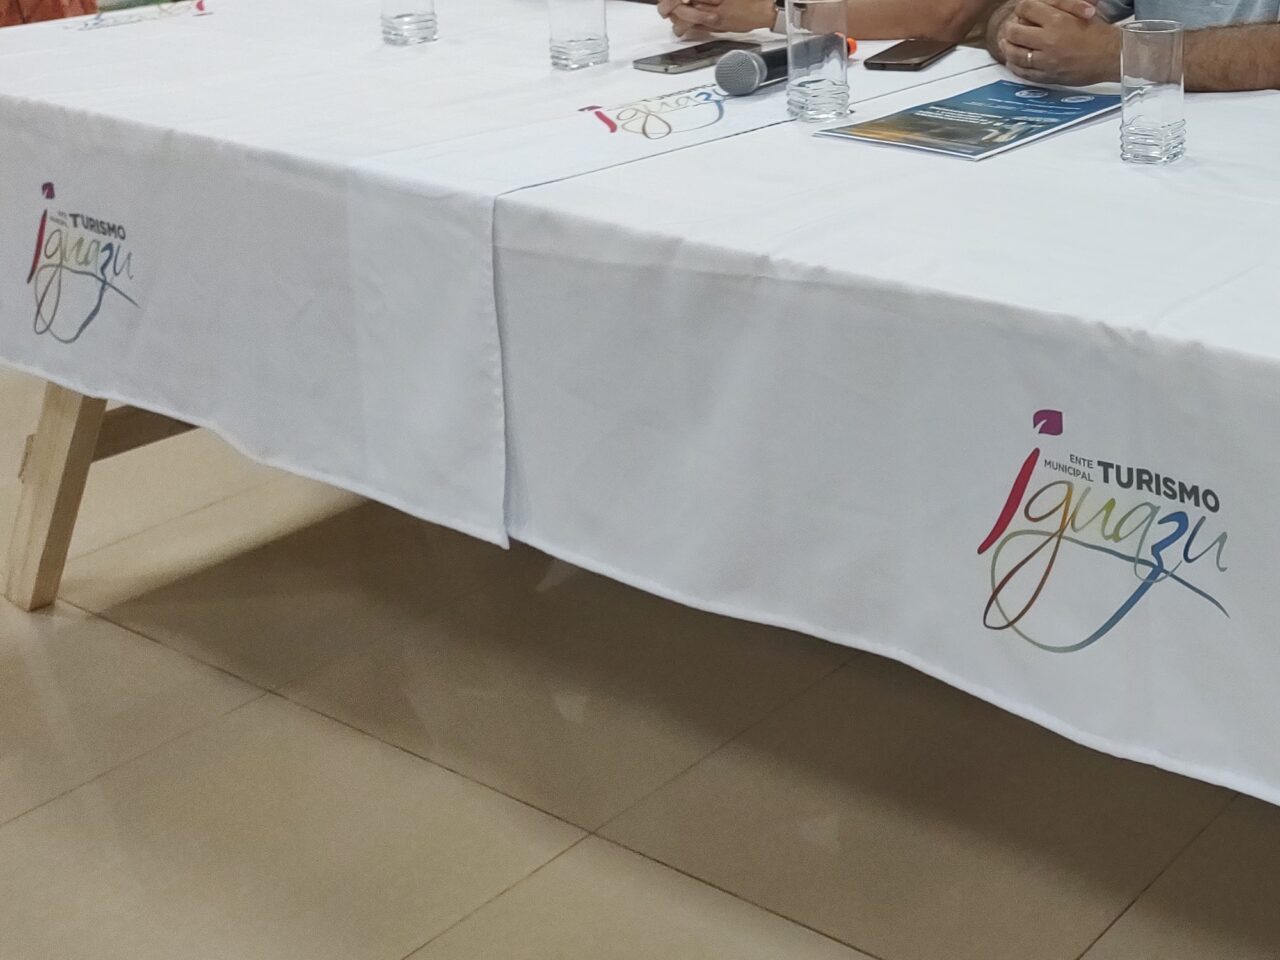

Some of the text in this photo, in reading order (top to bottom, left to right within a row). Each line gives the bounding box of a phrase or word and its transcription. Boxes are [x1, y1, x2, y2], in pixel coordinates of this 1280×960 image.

[69, 213, 126, 241] TURISMO
[1044, 458, 1095, 482] MUNICIPAL
[1069, 453, 1095, 469] ENTE
[1097, 460, 1221, 514] TURISMO
